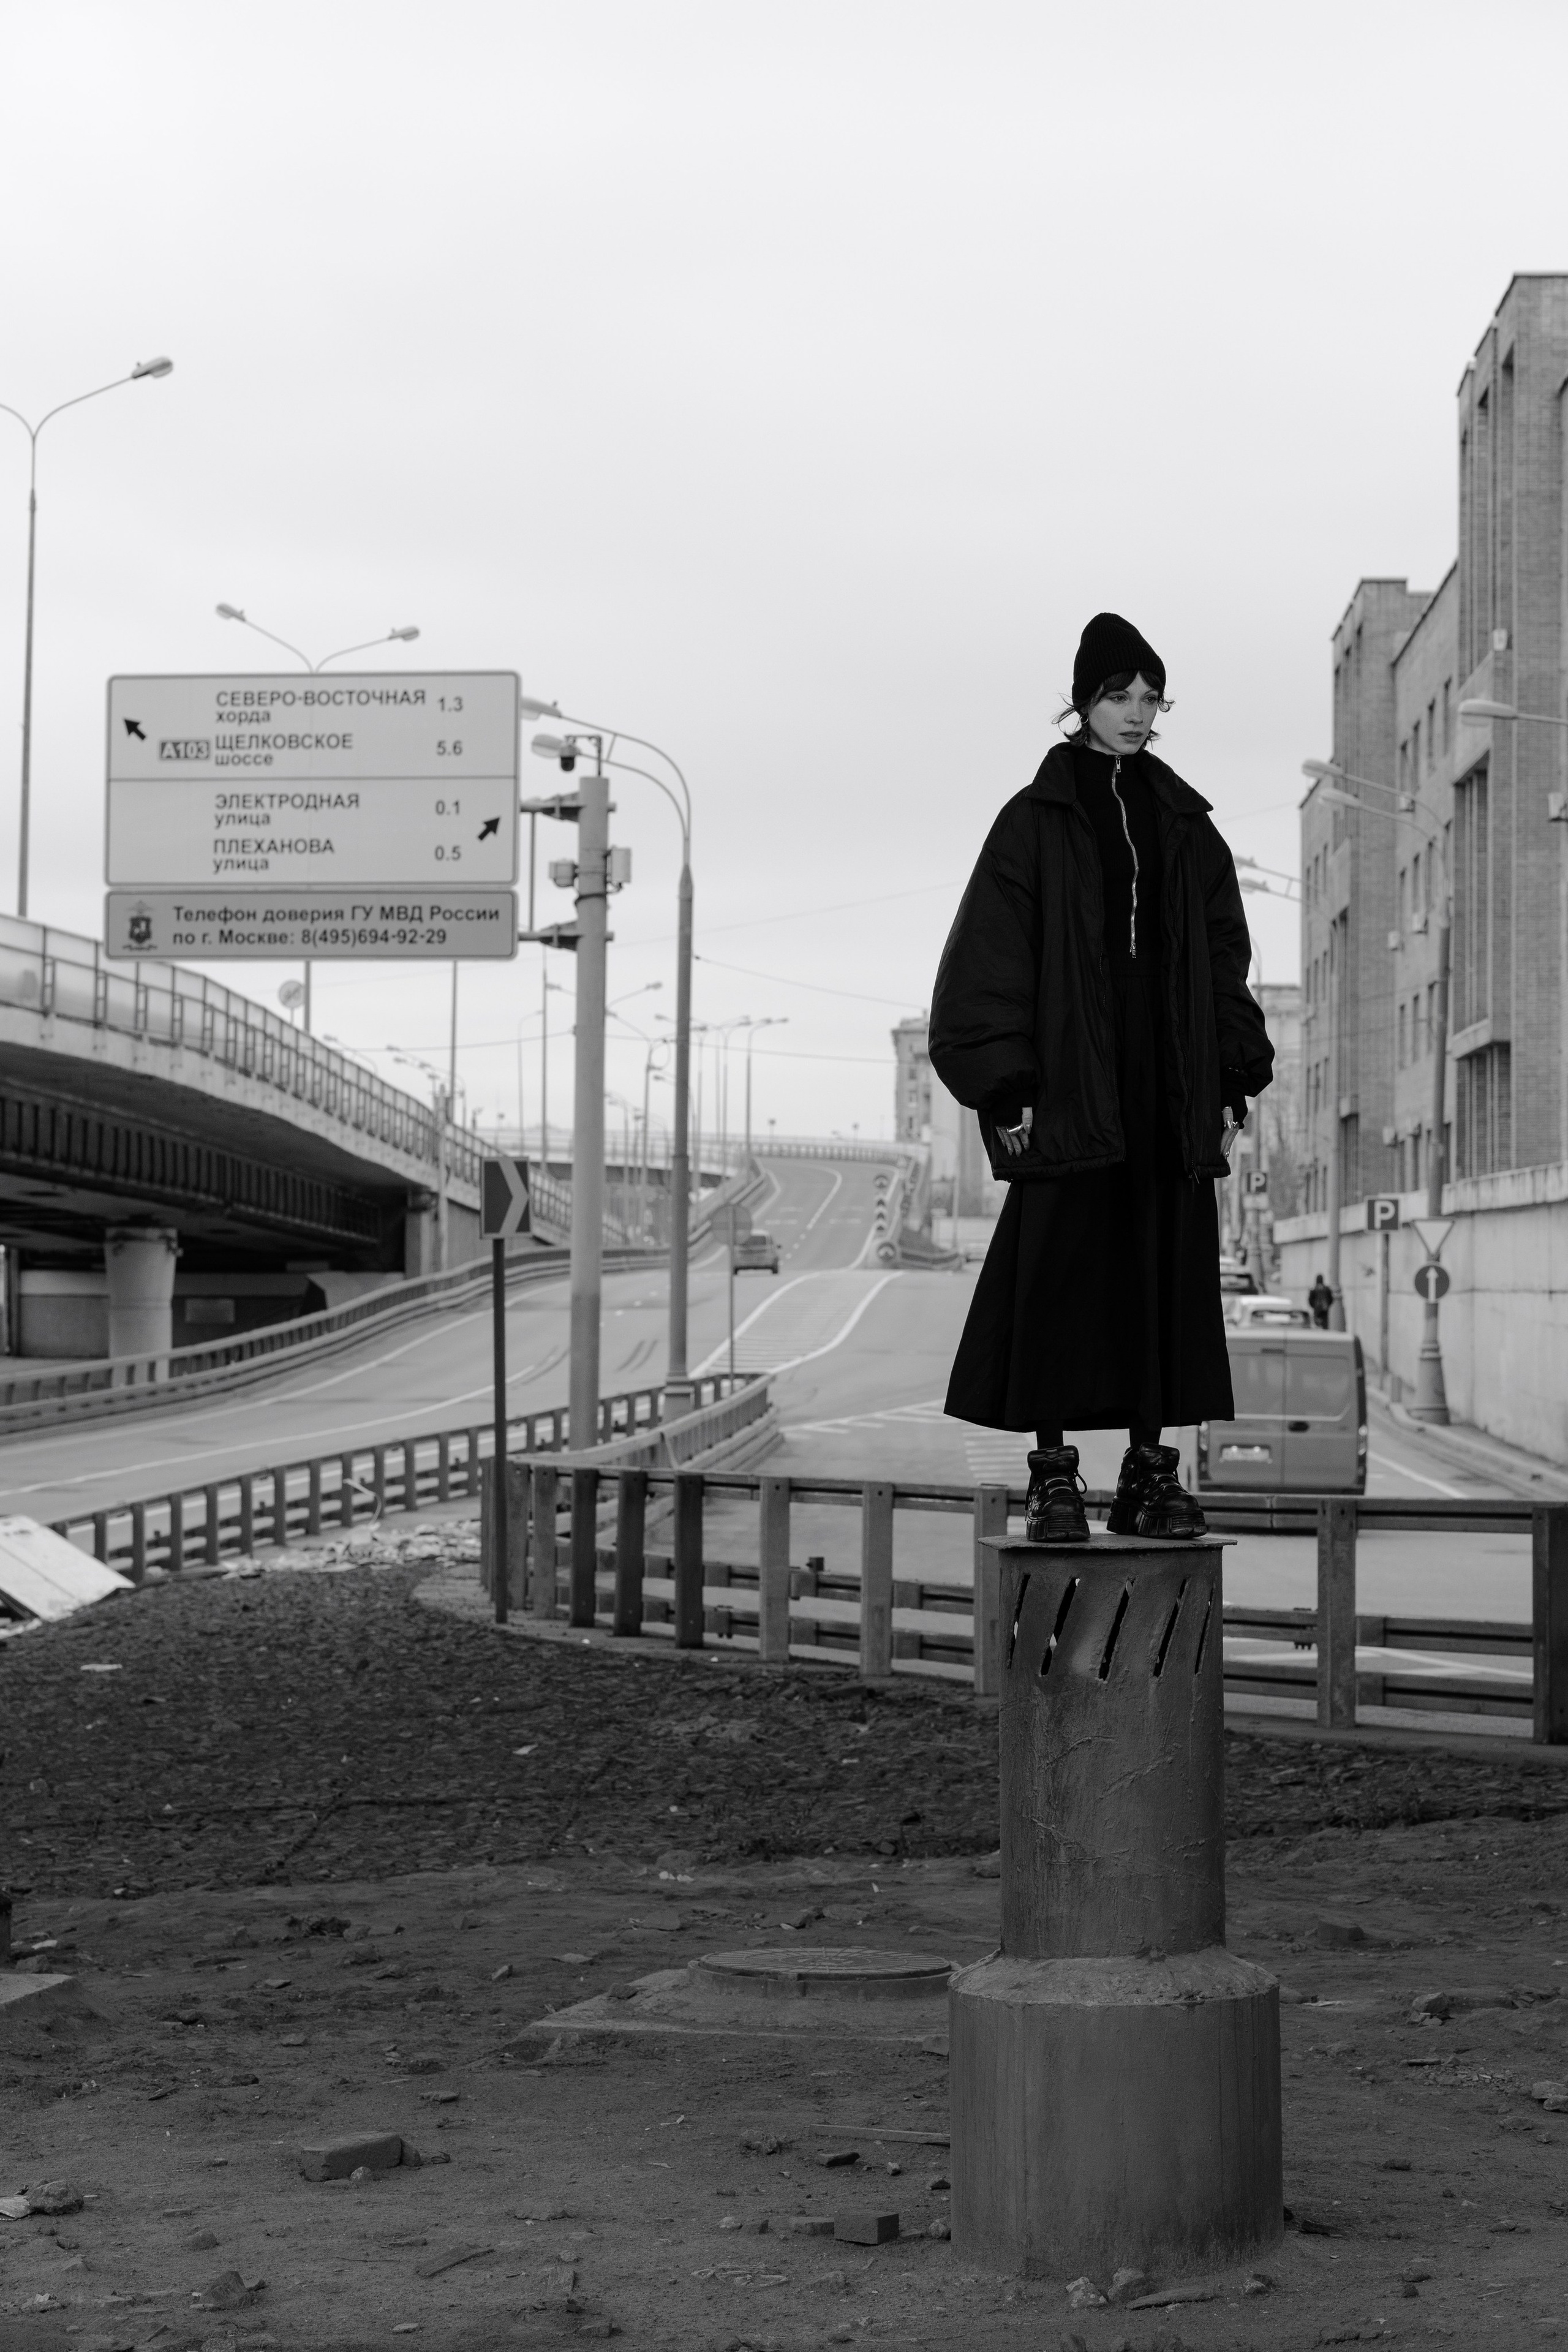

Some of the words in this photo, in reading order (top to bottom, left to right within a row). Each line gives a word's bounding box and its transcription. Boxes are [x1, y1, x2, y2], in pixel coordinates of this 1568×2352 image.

[216, 689, 426, 707] СЕВЕРО-ВОСТОЧНАЯ
[438, 696, 464, 712] 1.3
[216, 710, 271, 726] хорда
[215, 733, 352, 752] ЩЕЛКОВСКОЕ
[437, 740, 463, 756] 5.6
[214, 753, 274, 766] шоссе
[216, 793, 360, 811] ЭЛЕКТРОДНАЯ
[435, 799, 460, 816] 0.1
[214, 813, 271, 829] улица
[214, 838, 334, 854] ПЛЕХАНОВА
[434, 845, 462, 861] 0.5
[213, 858, 270, 874] улица
[173, 906, 257, 925] Телефон
[262, 909, 344, 925] доверия
[350, 905, 374, 922] ГУ
[380, 905, 423, 924] МВД
[429, 905, 500, 921] России
[173, 933, 196, 945] по
[202, 932, 212, 944] г.
[219, 929, 295, 945] Москве:
[301, 928, 447, 947] 8(495)694-92-29
[1250, 1172, 1266, 1192] P
[1374, 1200, 1396, 1229] P
